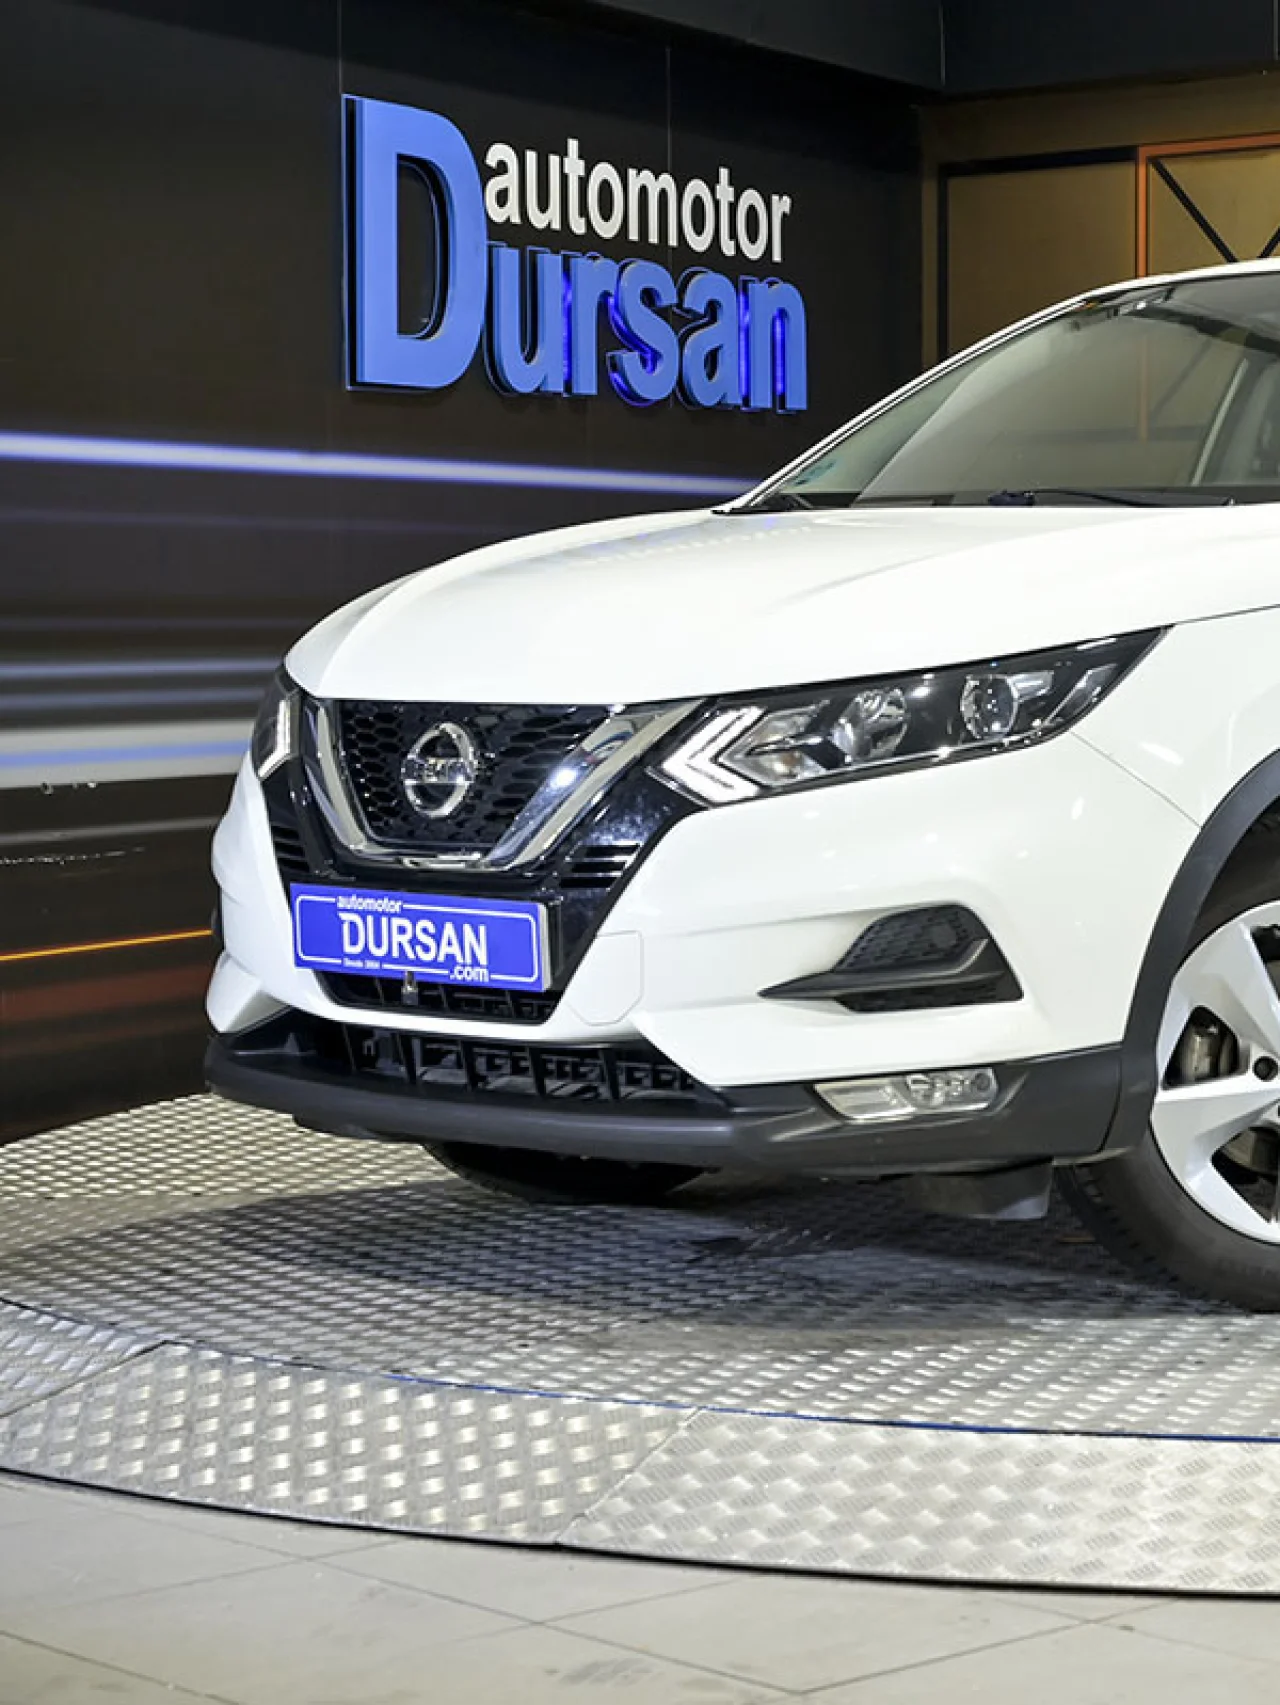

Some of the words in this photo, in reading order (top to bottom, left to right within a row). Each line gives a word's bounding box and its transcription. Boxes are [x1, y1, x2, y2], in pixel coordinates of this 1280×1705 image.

[484, 138, 791, 262] automotor
[342, 94, 808, 413] Dursan
[336, 894, 402, 913] automotor
[338, 912, 488, 966] DURSAN
[449, 965, 489, 982] .com
